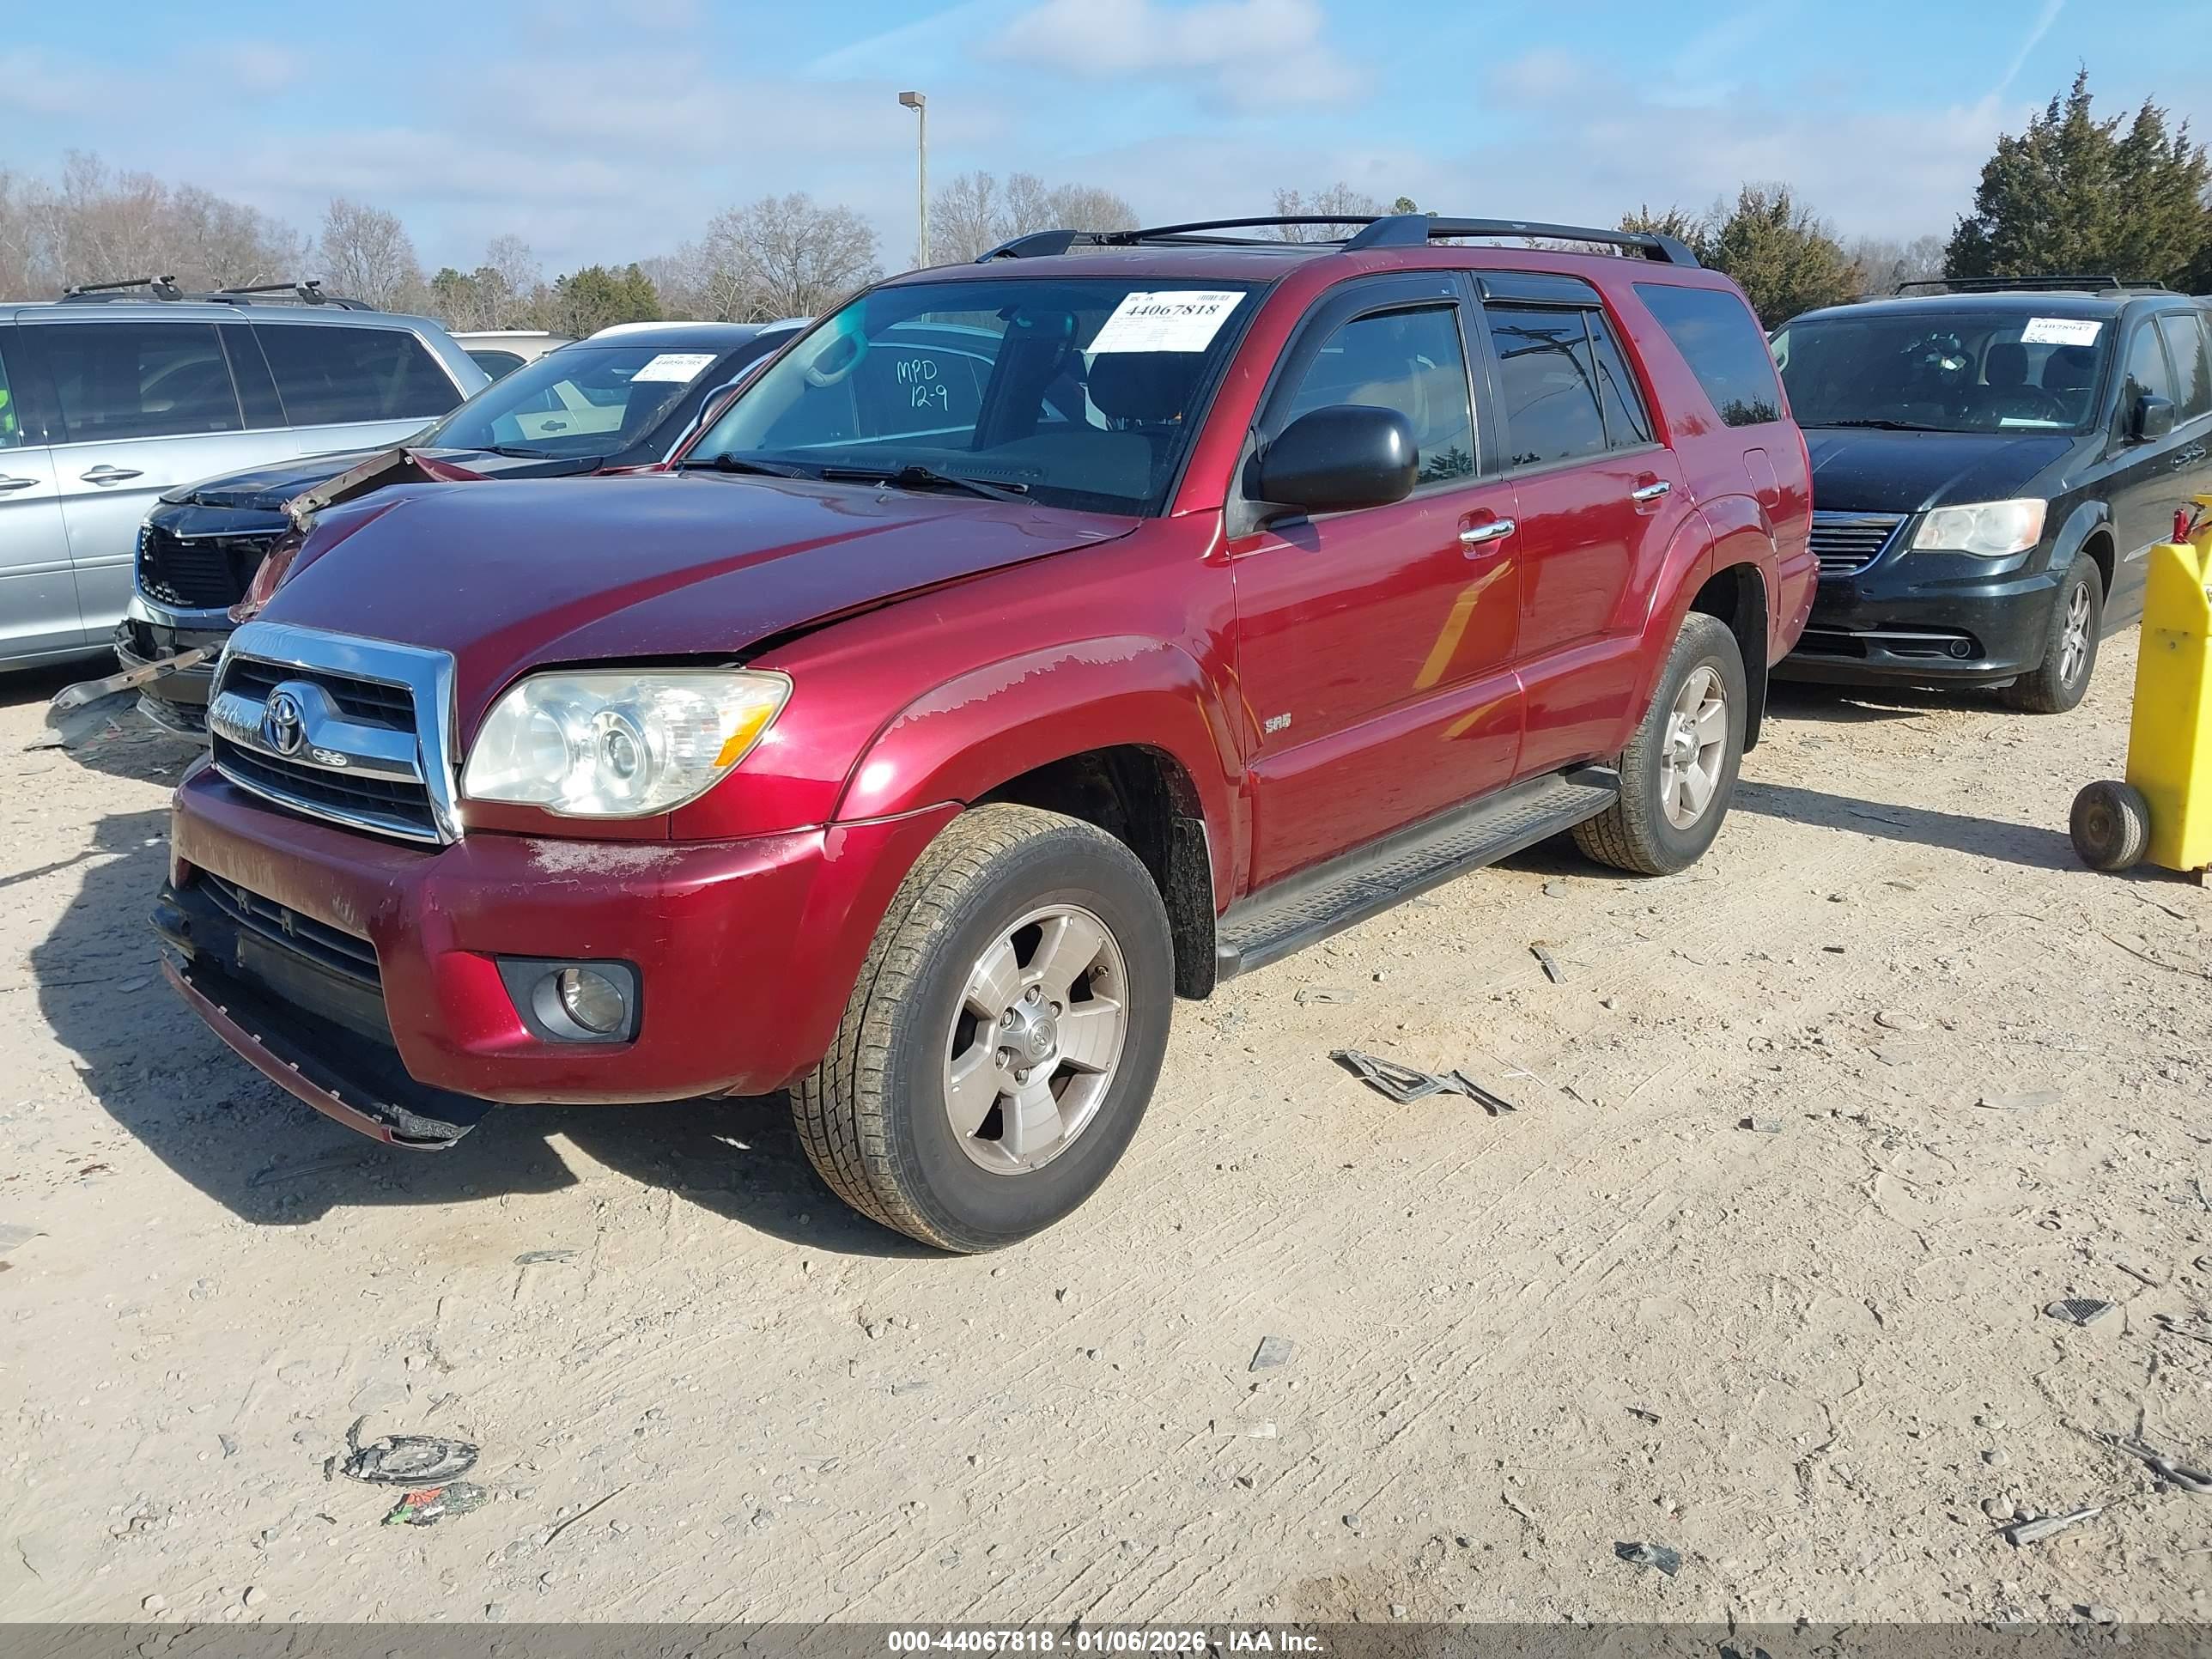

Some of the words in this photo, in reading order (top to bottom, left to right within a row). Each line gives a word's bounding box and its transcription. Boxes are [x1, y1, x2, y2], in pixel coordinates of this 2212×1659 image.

[1126, 304, 1220, 316] 44067818
[896, 359, 938, 384] MPD
[911, 384, 948, 411] 12-9
